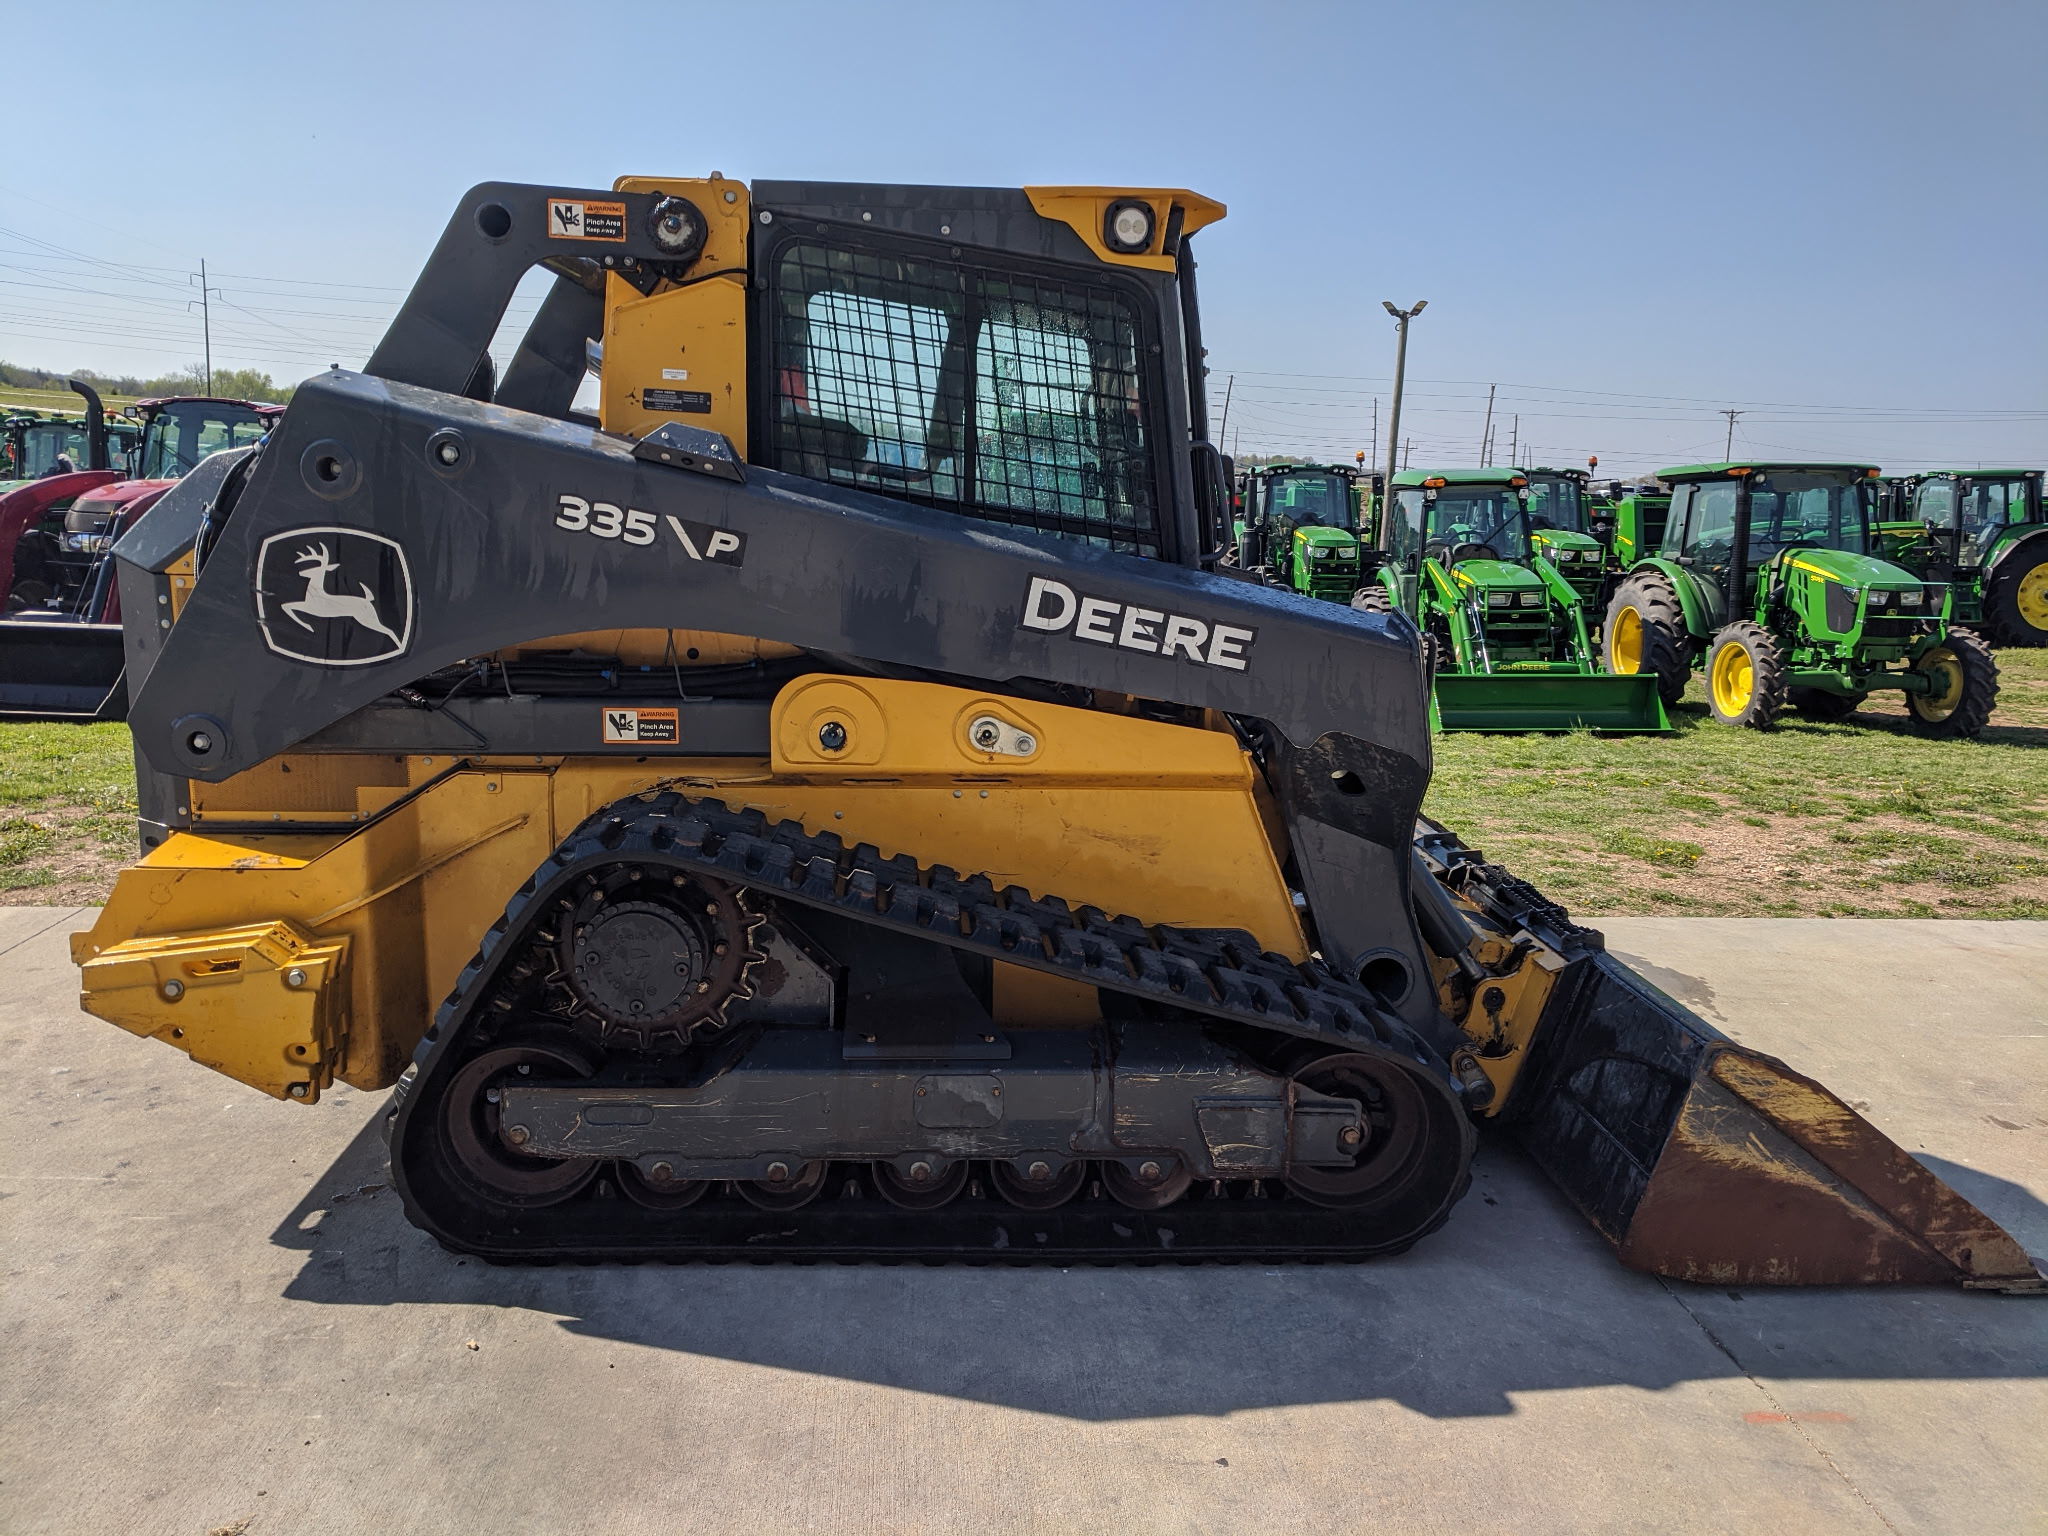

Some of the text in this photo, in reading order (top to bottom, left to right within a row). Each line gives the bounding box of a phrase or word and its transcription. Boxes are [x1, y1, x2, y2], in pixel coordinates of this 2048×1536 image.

[606, 219, 621, 227] Area
[556, 495, 657, 545] 335
[1022, 576, 1253, 670] DEERE
